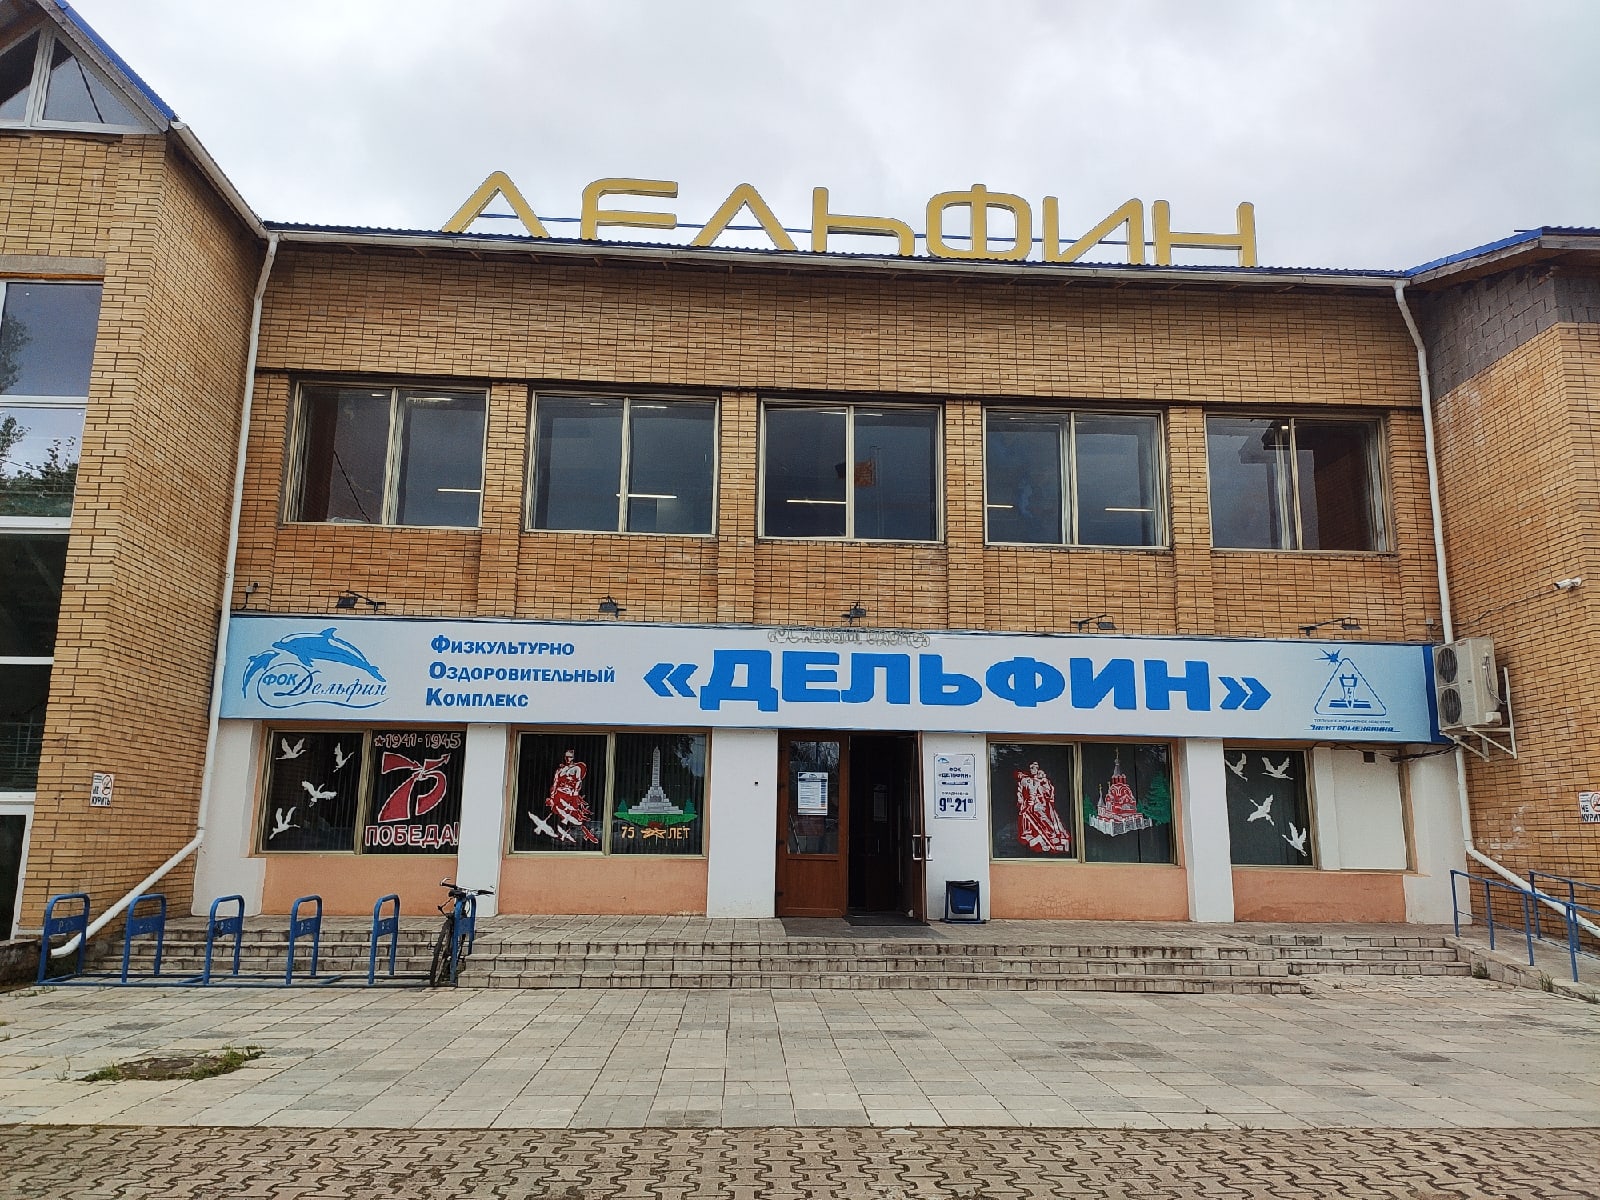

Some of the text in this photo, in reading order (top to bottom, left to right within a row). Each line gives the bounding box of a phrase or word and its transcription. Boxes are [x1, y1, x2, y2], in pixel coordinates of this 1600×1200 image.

[431, 635, 575, 655] ФИЗКУЛЬТУРНО
[429, 661, 615, 683] ОЗДОРОВИТЕЛЬНЫЙ
[643, 649, 1272, 712] «ДЕЛЬФИН»
[262, 670, 387, 702] ФОК Дельфин
[426, 688, 529, 707] КОМПЛЕКС
[378, 752, 451, 823] 75
[1581, 814, 1600, 822] КУРИ
[365, 822, 459, 849] ПОБЕДА!
[621, 826, 691, 839] 75 ЛЕТ
